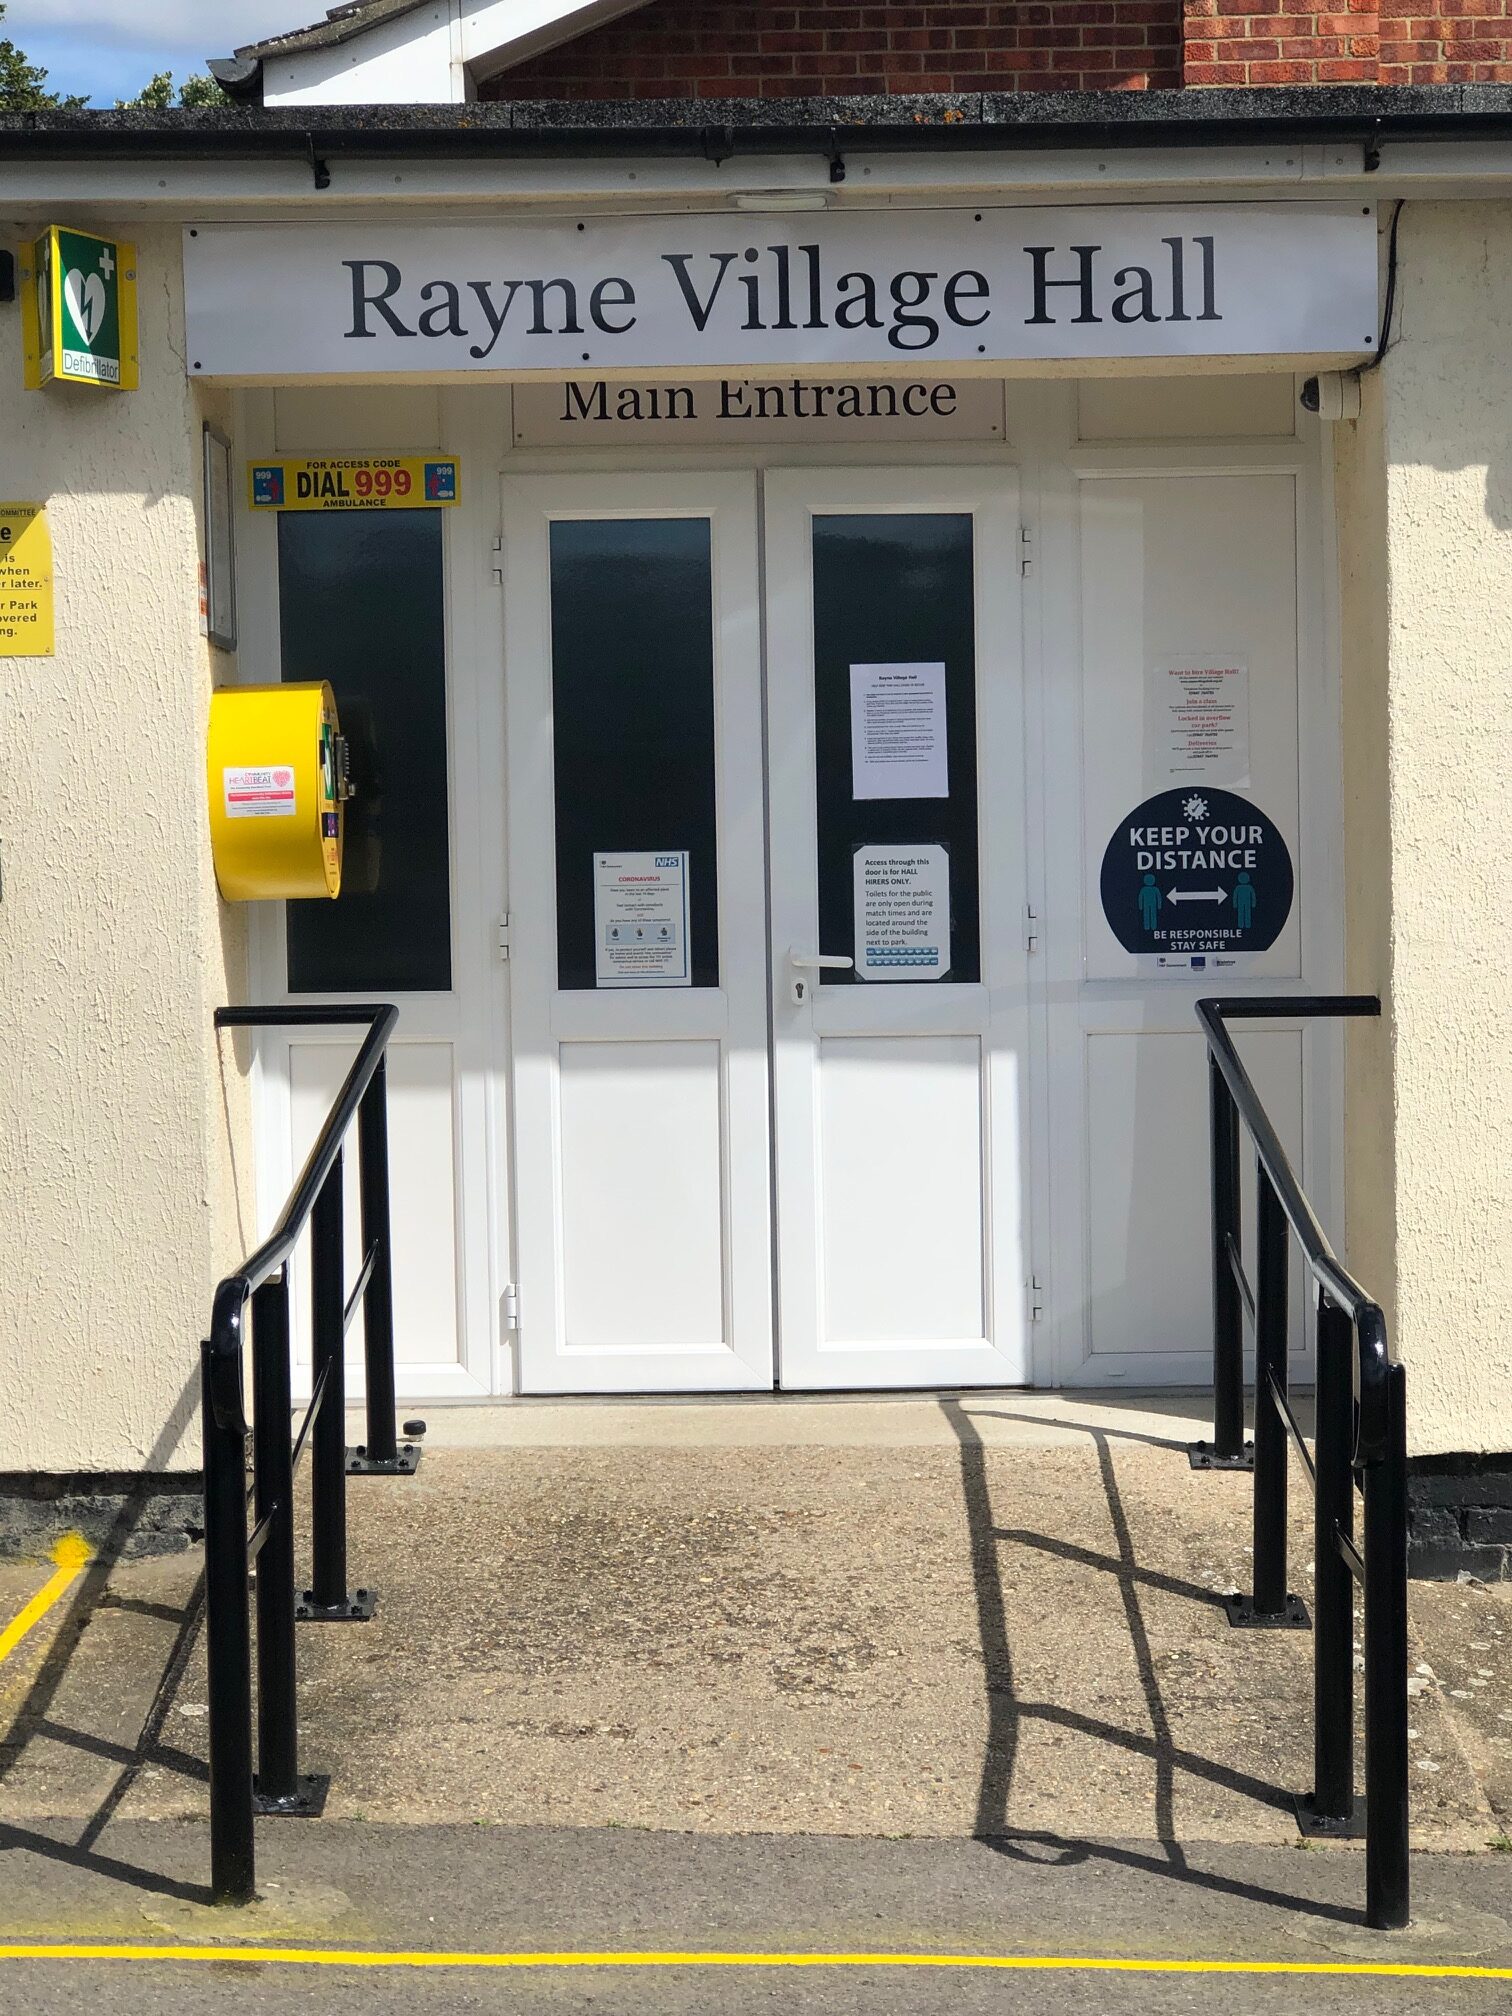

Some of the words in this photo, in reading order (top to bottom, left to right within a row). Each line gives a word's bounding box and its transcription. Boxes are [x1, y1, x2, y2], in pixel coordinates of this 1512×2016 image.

[341, 260, 637, 359] Rayne
[660, 244, 991, 350] Village
[1023, 236, 1223, 324] Hall
[64, 353, 118, 379] Defibrillator
[560, 381, 698, 421] Main
[715, 379, 957, 419] Entrance
[306, 461, 327, 469] FOR
[330, 460, 370, 469] ACCESS
[373, 460, 401, 468] CODE
[255, 471, 272, 480] 999
[436, 467, 453, 475] 999
[297, 470, 350, 498] DIAL
[354, 469, 412, 497] 999
[323, 499, 387, 508] AMBULANCE
[11, 579, 43, 588] later.
[10, 600, 38, 610] Park
[1129, 826, 1190, 847] KEEP
[1195, 825, 1263, 845] YOUR
[656, 858, 678, 867] NHS
[888, 858, 915, 867] through
[916, 858, 930, 866] this
[1137, 849, 1257, 870] DISTANCE
[864, 868, 881, 876] door
[882, 868, 888, 876] is
[865, 878, 890, 886] HIRERS
[865, 890, 887, 898] Toilets
[912, 889, 933, 898] public
[877, 900, 892, 908] only
[911, 900, 934, 908] during
[865, 919, 890, 927] located
[880, 928, 888, 936] of
[889, 928, 901, 936] the
[901, 928, 928, 937] building
[1153, 930, 1167, 940] BE
[1169, 929, 1242, 939] RESPONSIBLE
[890, 939, 908, 947] park.
[1170, 941, 1196, 951] STAY
[1199, 940, 1226, 950] SAFE
